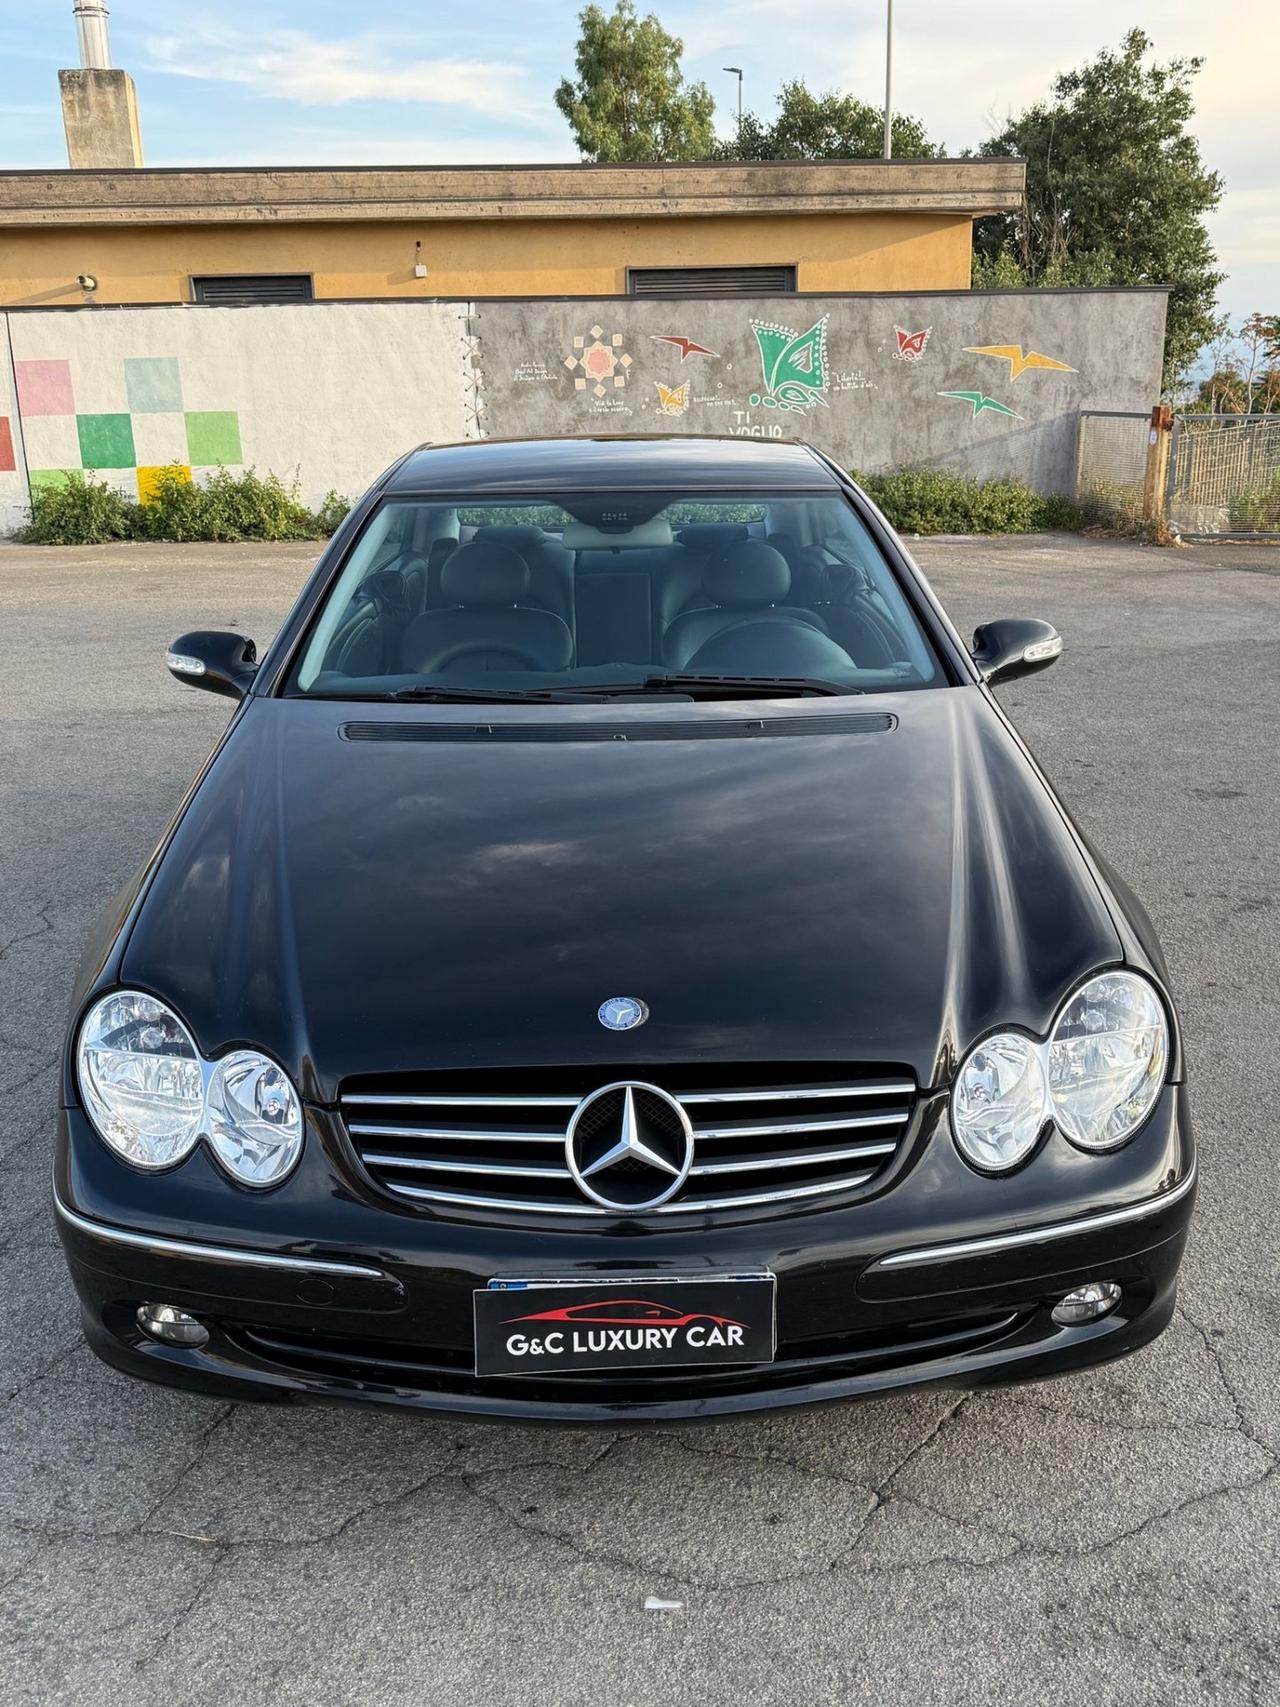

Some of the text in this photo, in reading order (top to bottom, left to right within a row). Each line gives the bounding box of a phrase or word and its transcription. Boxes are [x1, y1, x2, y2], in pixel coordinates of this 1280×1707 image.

[733, 411, 750, 425] TI
[506, 1325, 744, 1356] G&C LUXURY CAR
